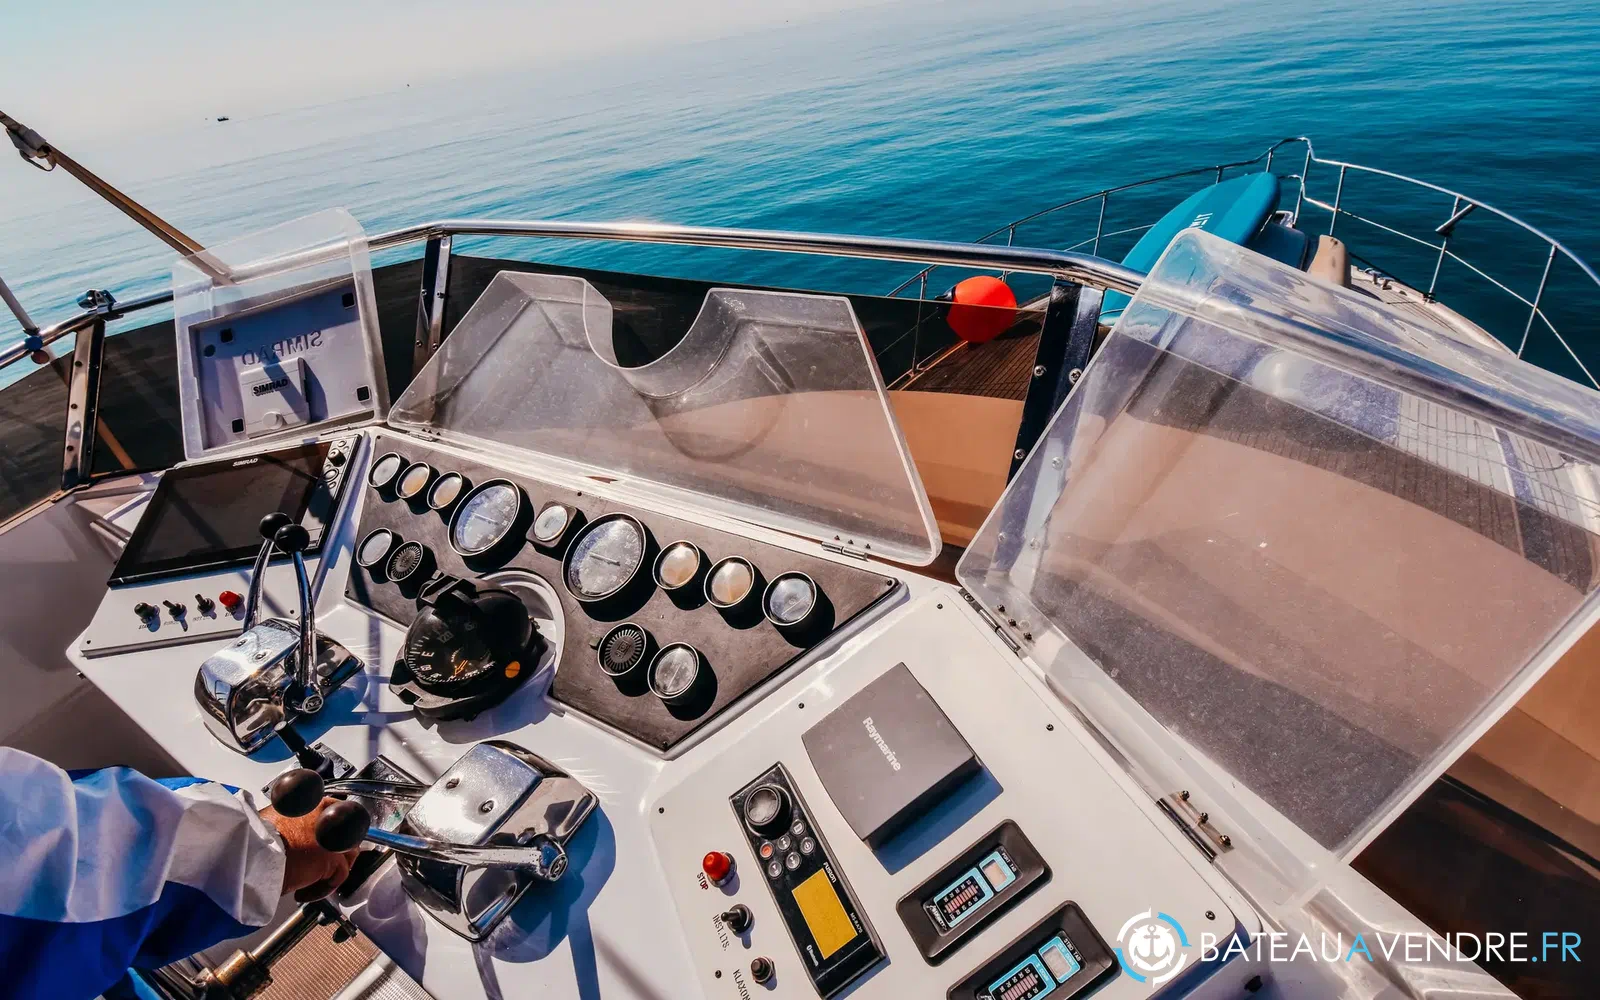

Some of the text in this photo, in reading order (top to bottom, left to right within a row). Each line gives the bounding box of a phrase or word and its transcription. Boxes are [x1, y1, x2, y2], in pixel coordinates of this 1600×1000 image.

[253, 378, 289, 395] SIMRAD
[232, 457, 259, 467] SIMRAD
[862, 716, 901, 771] Raymarine
[696, 872, 709, 890] STOP
[733, 969, 751, 1000] KLAXON
